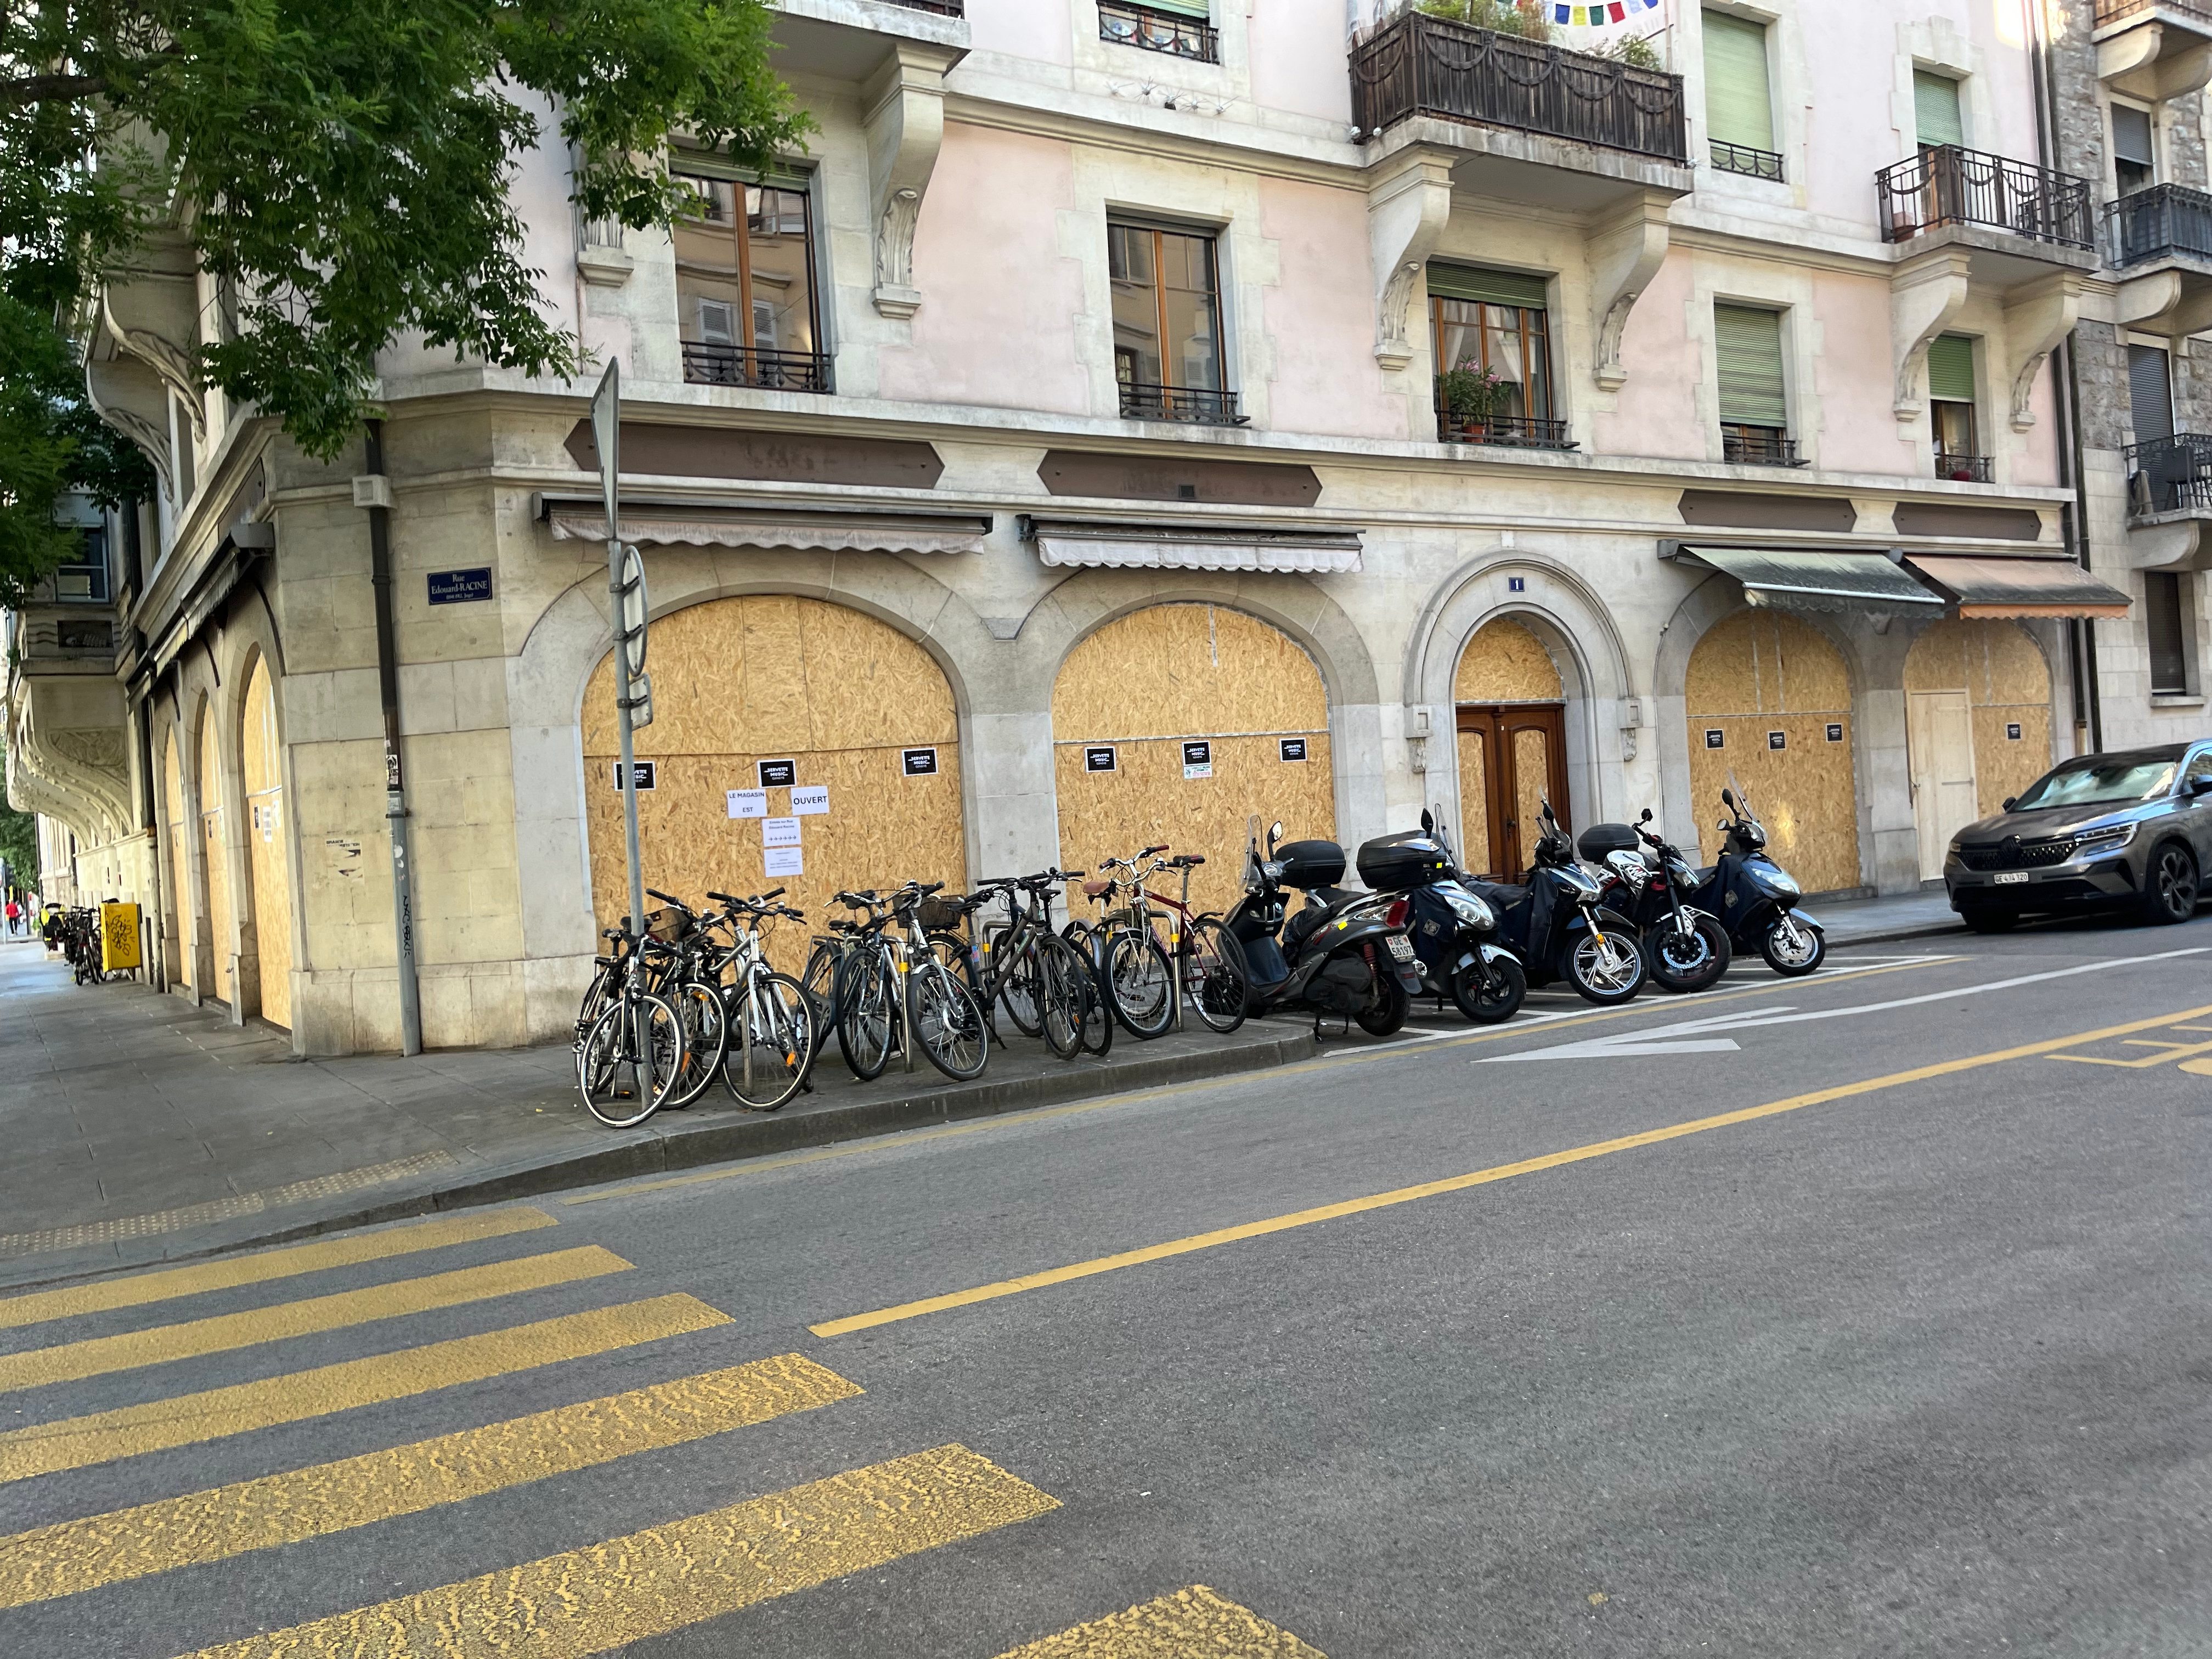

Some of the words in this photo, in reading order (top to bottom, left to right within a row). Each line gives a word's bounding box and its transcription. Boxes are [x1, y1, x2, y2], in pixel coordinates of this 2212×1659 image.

[452, 574, 465, 583] Rue
[431, 580, 488, 595] Edouard-RACINE
[1515, 579, 1519, 590] 1
[793, 795, 827, 805] OUVERT
[1393, 936, 1403, 945] GE
[1391, 945, 1412, 956] 58197
